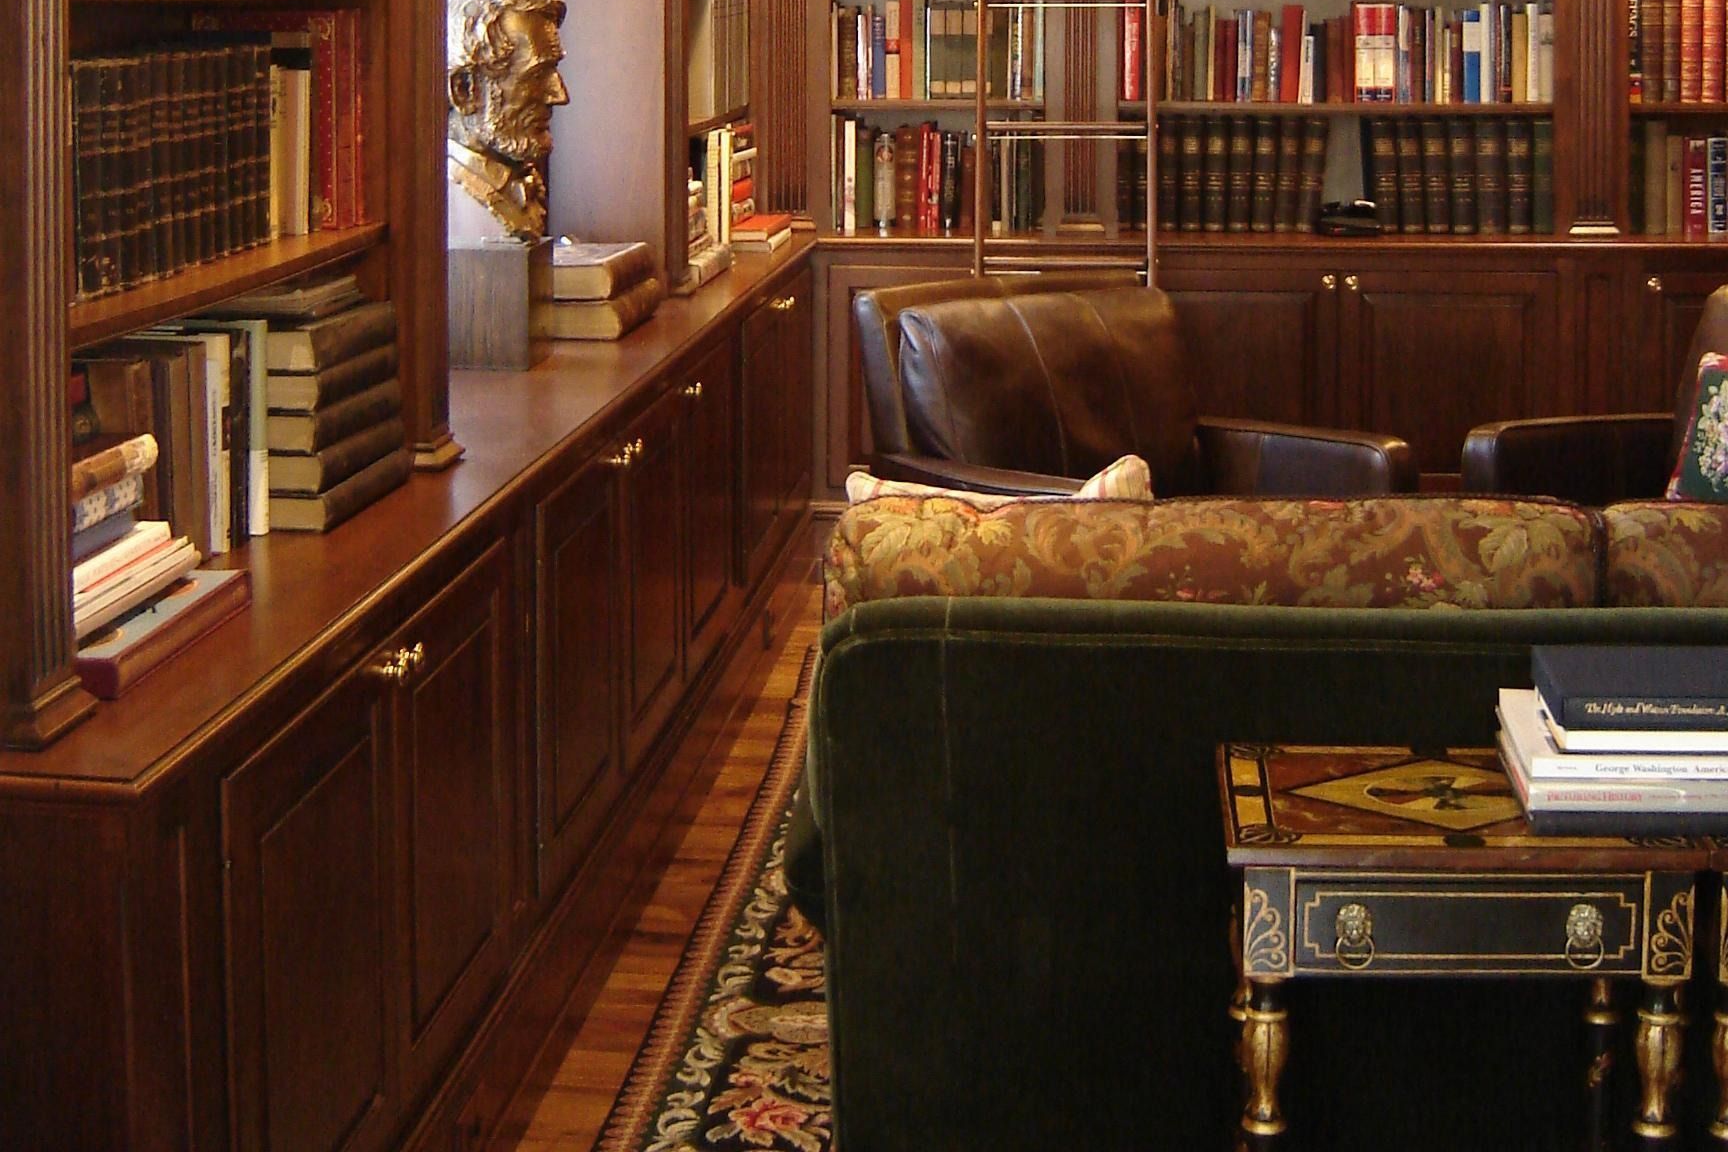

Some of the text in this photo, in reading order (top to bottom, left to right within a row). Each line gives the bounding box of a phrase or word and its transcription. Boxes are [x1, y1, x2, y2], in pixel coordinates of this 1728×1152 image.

[1690, 168, 1705, 215] AMERICA
[1585, 702, 1601, 714] The
[1595, 763, 1728, 775] George Washington Americ
[1547, 791, 1601, 801] PICTURING
[1602, 791, 1643, 801] HISTORY
